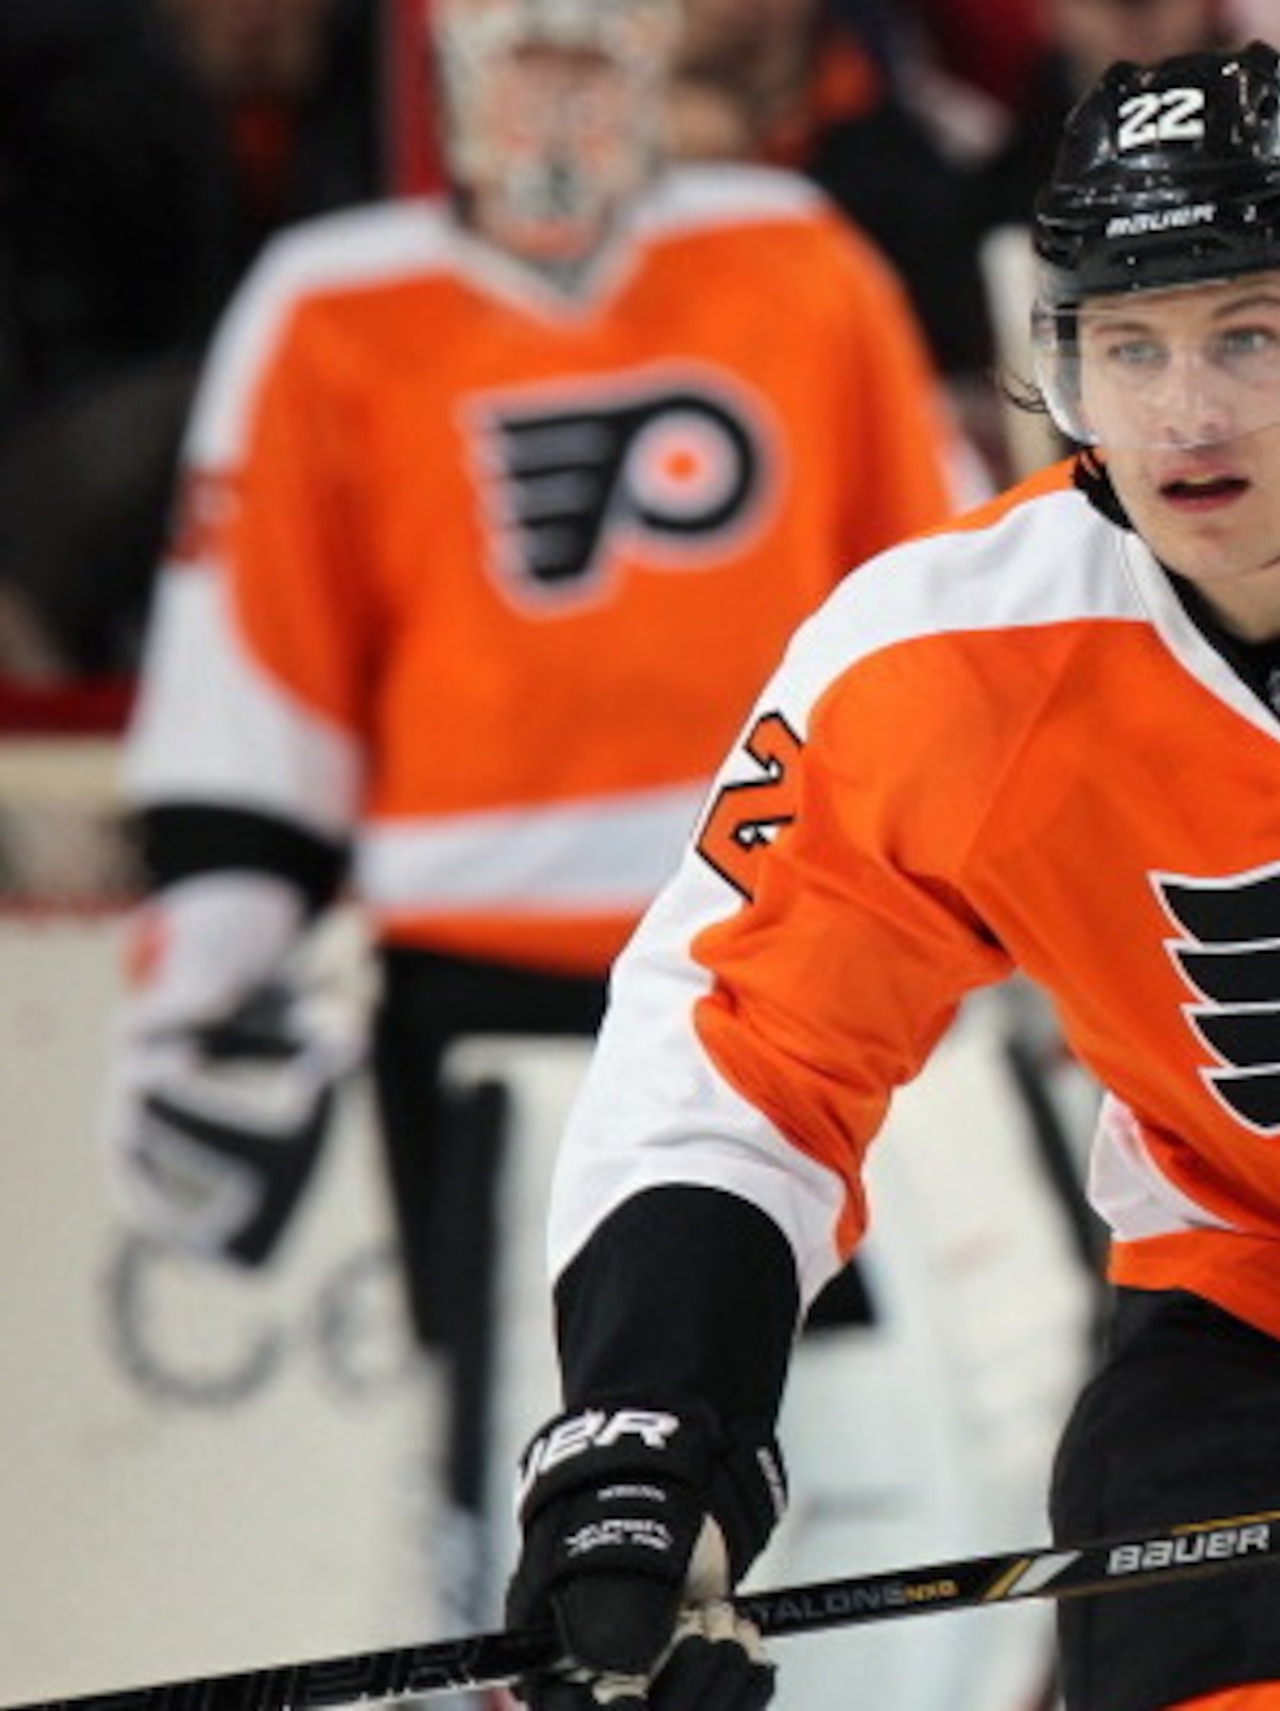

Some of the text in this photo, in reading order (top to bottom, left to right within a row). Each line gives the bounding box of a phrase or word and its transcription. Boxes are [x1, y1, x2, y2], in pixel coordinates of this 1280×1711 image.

[1117, 87, 1205, 150] 22
[1105, 203, 1217, 239] BAUER
[1106, 1524, 1270, 1575] BAUER
